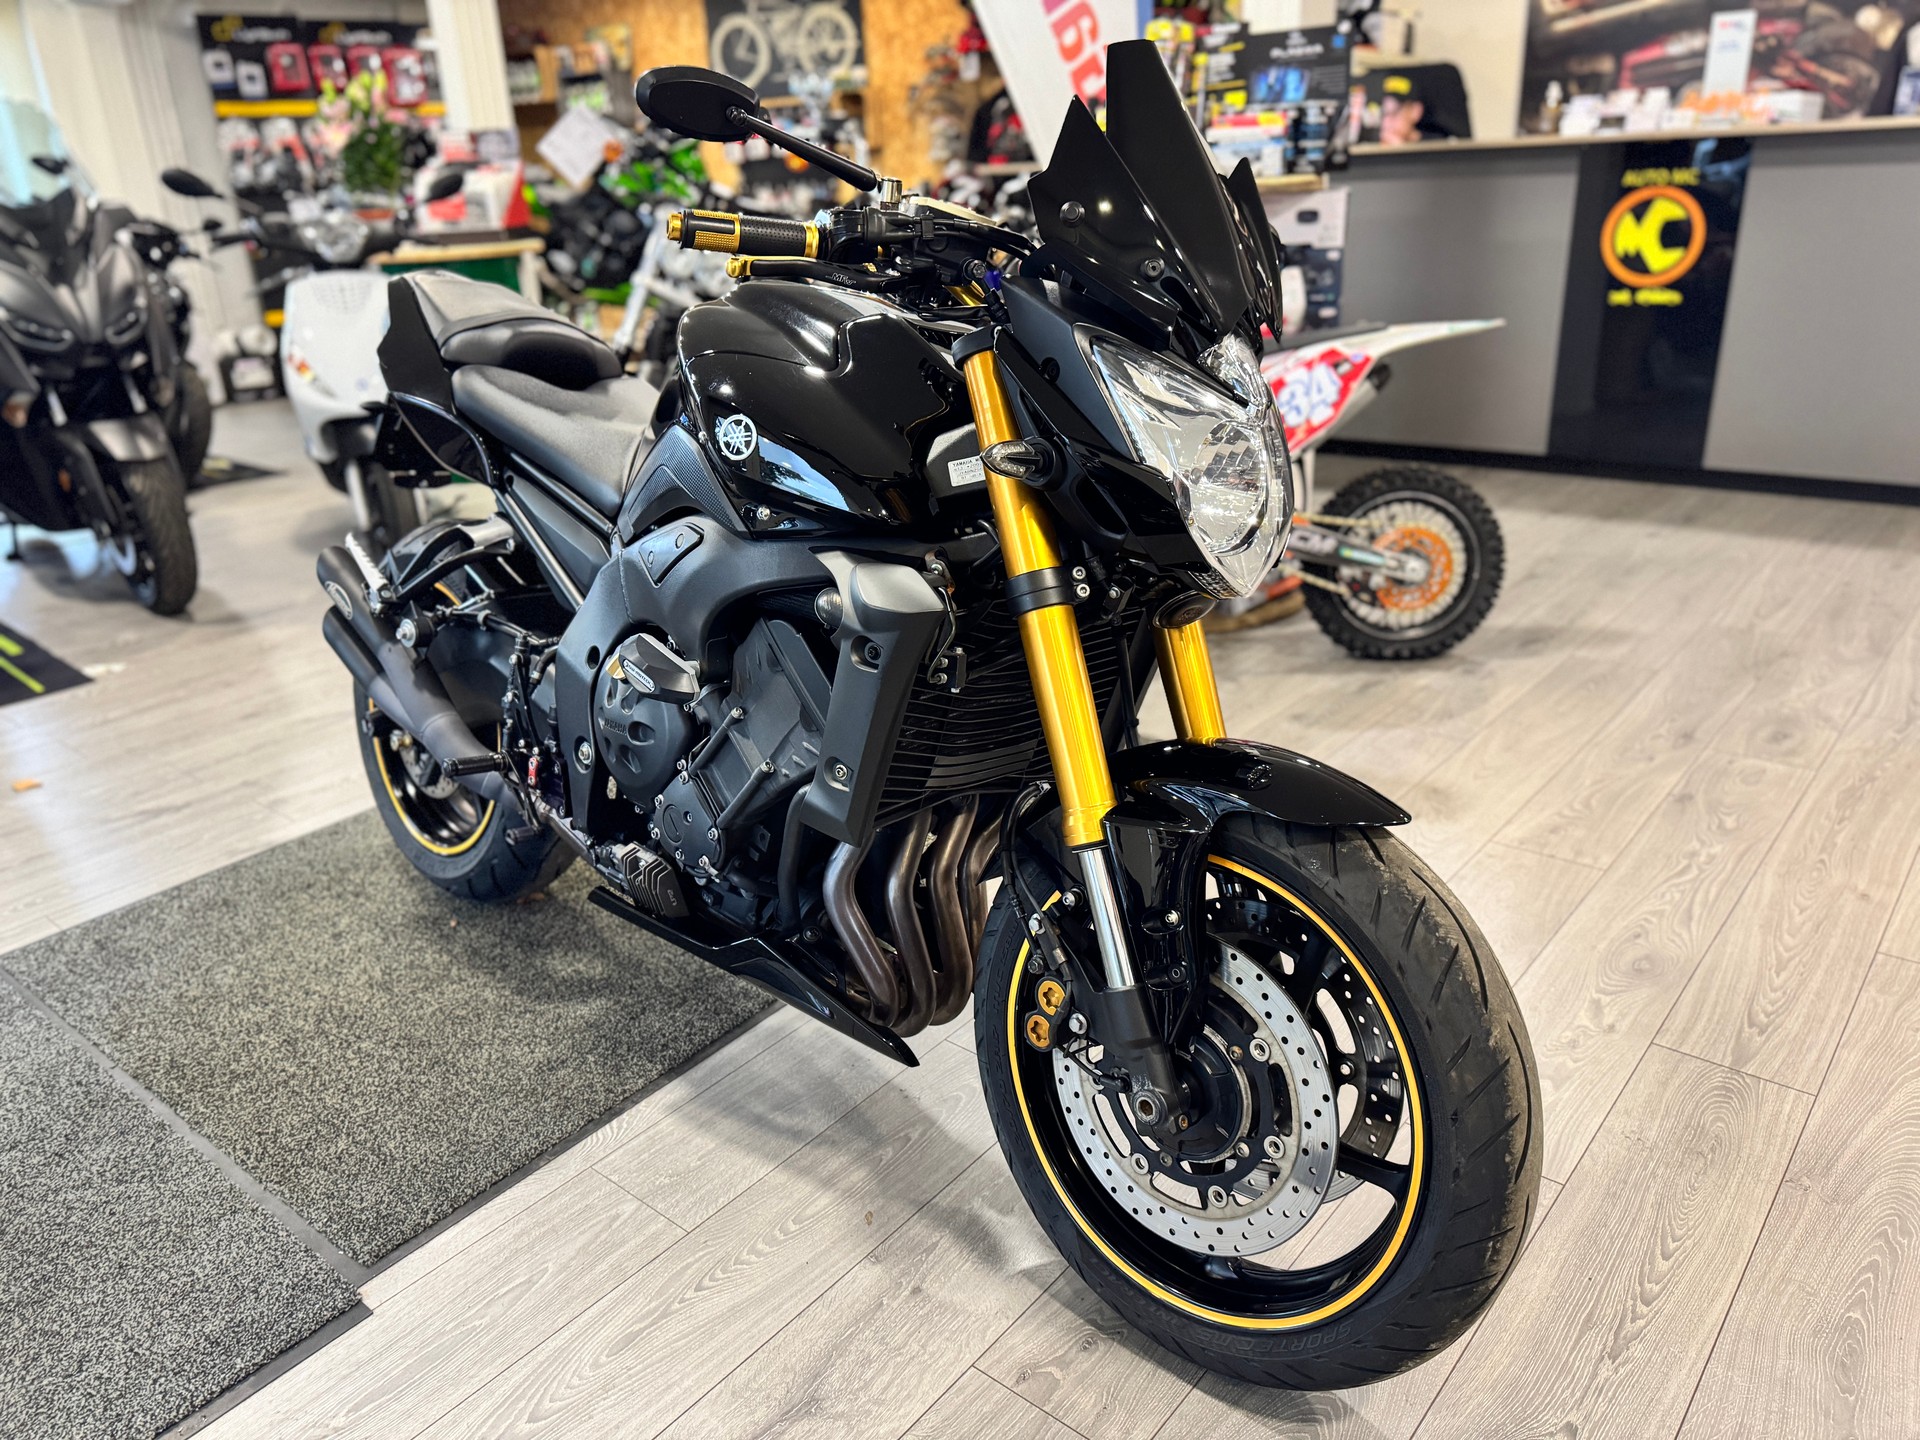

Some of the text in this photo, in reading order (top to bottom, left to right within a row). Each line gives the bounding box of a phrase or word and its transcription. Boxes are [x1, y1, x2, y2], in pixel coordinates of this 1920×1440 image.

[1621, 167, 1702, 188] AUTO MC
[952, 459, 973, 467] YAMAHA
[1234, 1317, 1354, 1353] SPORTEC
